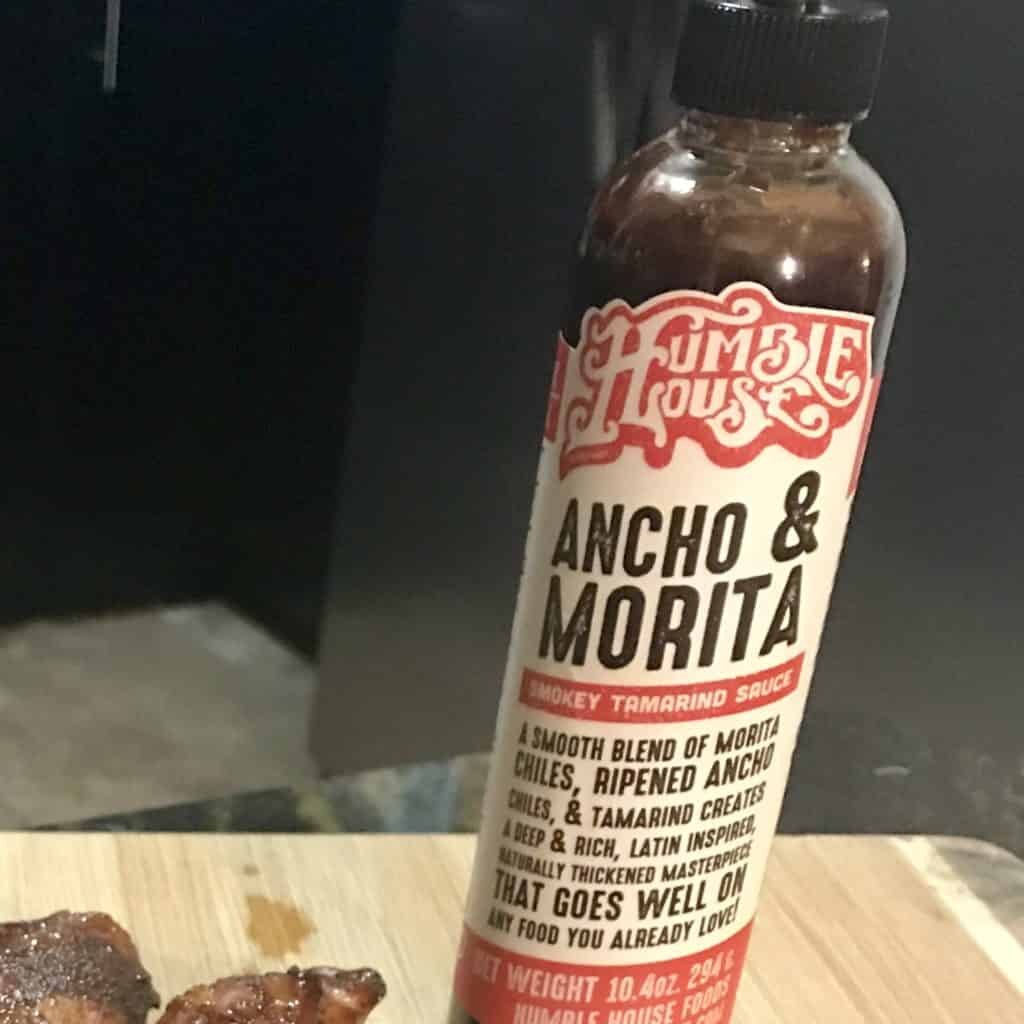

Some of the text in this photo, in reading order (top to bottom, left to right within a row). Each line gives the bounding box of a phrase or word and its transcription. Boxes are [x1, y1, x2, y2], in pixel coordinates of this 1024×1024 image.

[551, 470, 821, 579] ANCHO &
[538, 564, 803, 671] MORITA
[529, 668, 793, 712] SMOKEY TAMARIND SAUCE
[518, 714, 780, 763] A SMOOTH BLEND OF MORITA
[514, 742, 775, 797] CHILES, RIPENED ANCHO
[508, 781, 767, 829] CHILES, & TAMARIND CREATES
[498, 840, 752, 885] NATURALLY THICKENED MASTERPIECE
[514, 822, 545, 848] DEEP
[550, 829, 566, 853] &
[574, 836, 620, 862] RICH,
[630, 834, 682, 859] LATIN
[687, 814, 756, 852] INSPIRED,
[494, 863, 748, 921] THAT GOES WELL ON
[488, 896, 740, 950] ANY FOOD YOU ALREADY LOVE!
[506, 962, 599, 1003] WEIGHT
